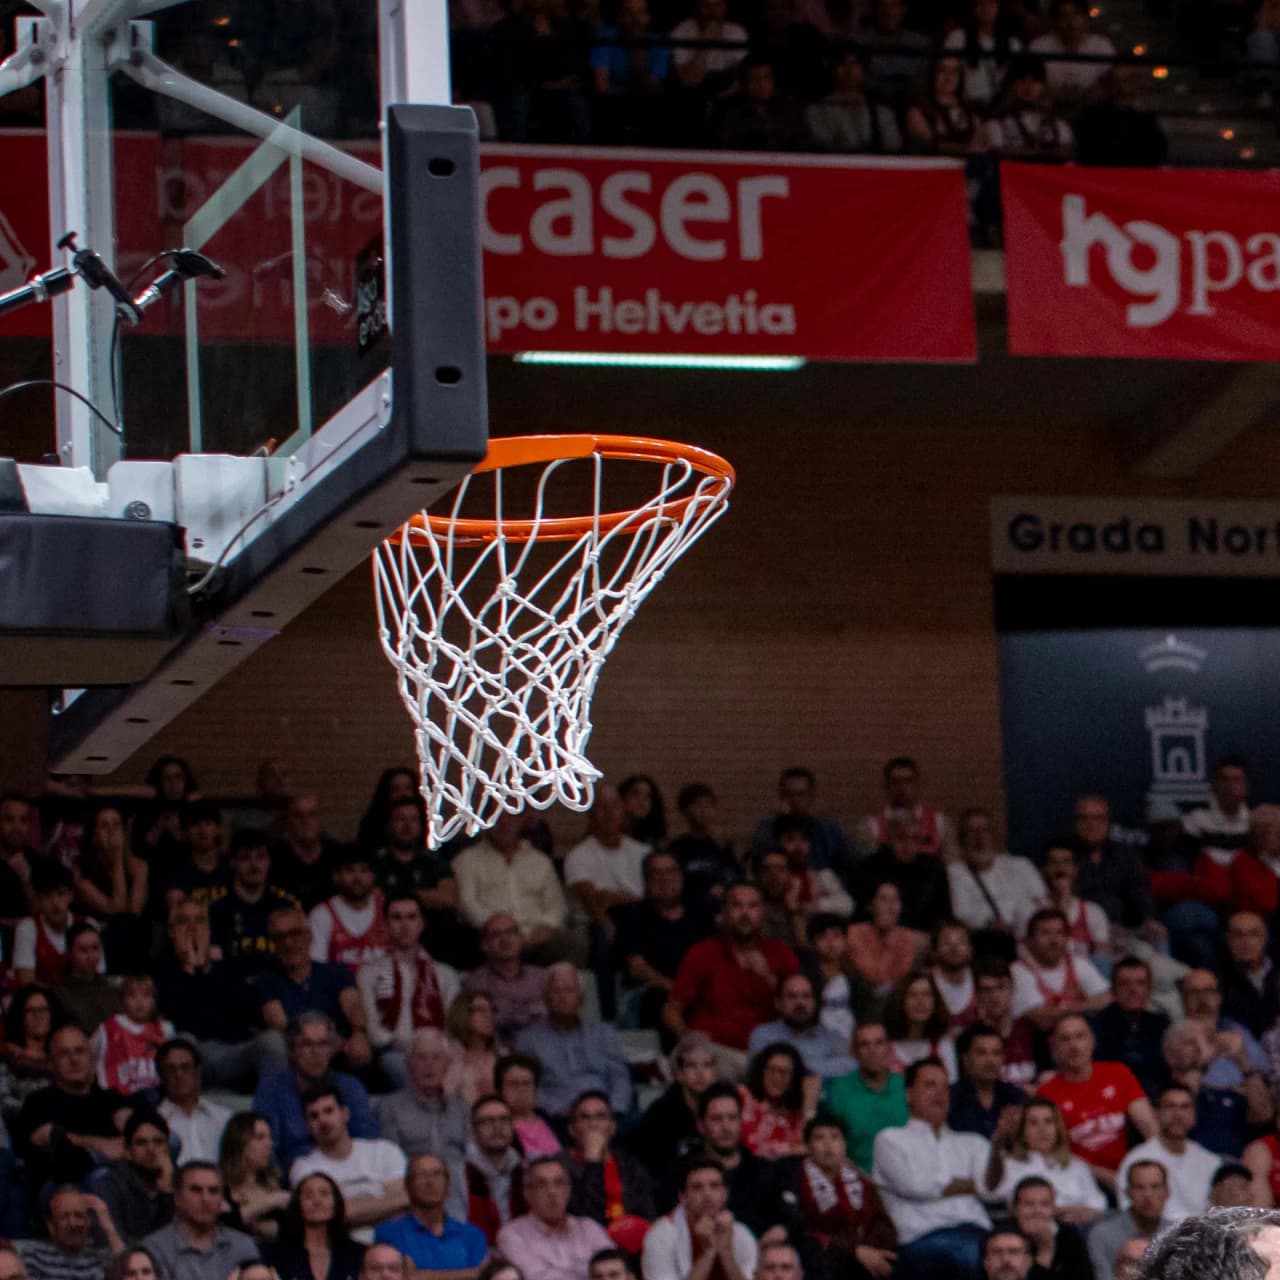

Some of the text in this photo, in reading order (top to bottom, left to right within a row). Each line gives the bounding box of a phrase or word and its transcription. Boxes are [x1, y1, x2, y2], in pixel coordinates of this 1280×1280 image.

[479, 165, 791, 262] caser
[573, 286, 797, 335] Helvetia
[1008, 512, 1165, 553] Grada
